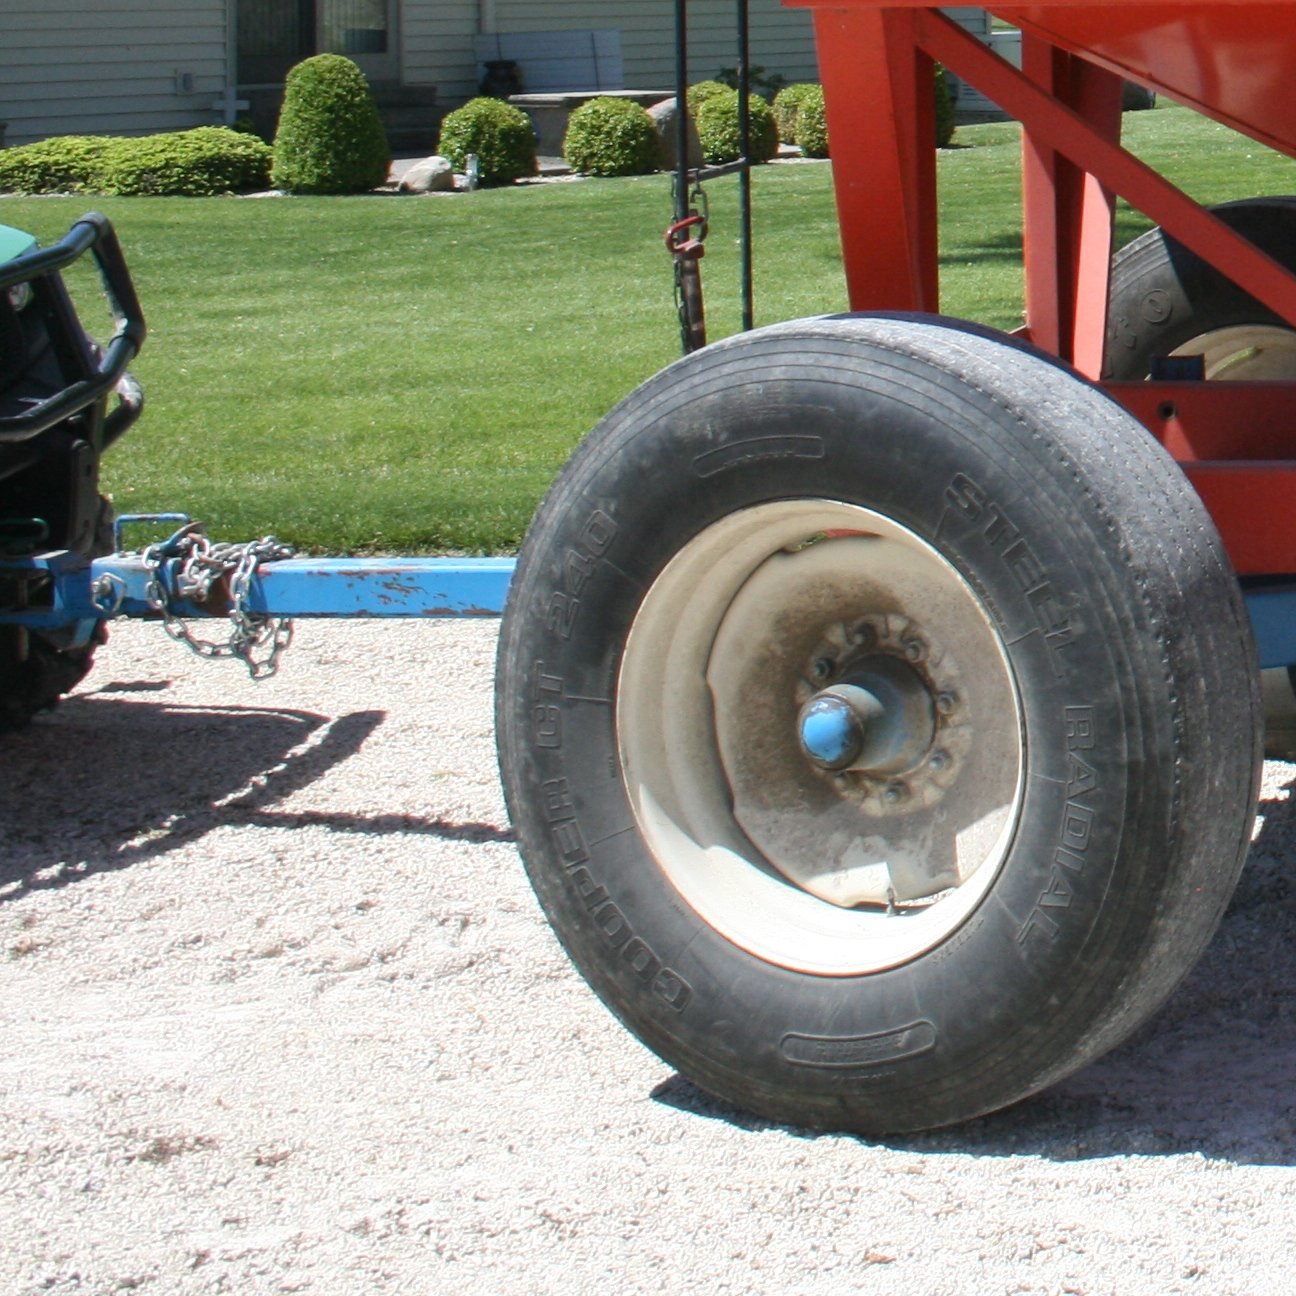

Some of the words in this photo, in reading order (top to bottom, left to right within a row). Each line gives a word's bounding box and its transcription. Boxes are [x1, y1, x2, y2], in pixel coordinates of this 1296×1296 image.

[549, 509, 618, 638] 240
[944, 472, 1075, 679] STEEL
[1017, 705, 1097, 943] RADIAL
[536, 780, 694, 1013] COOPER
